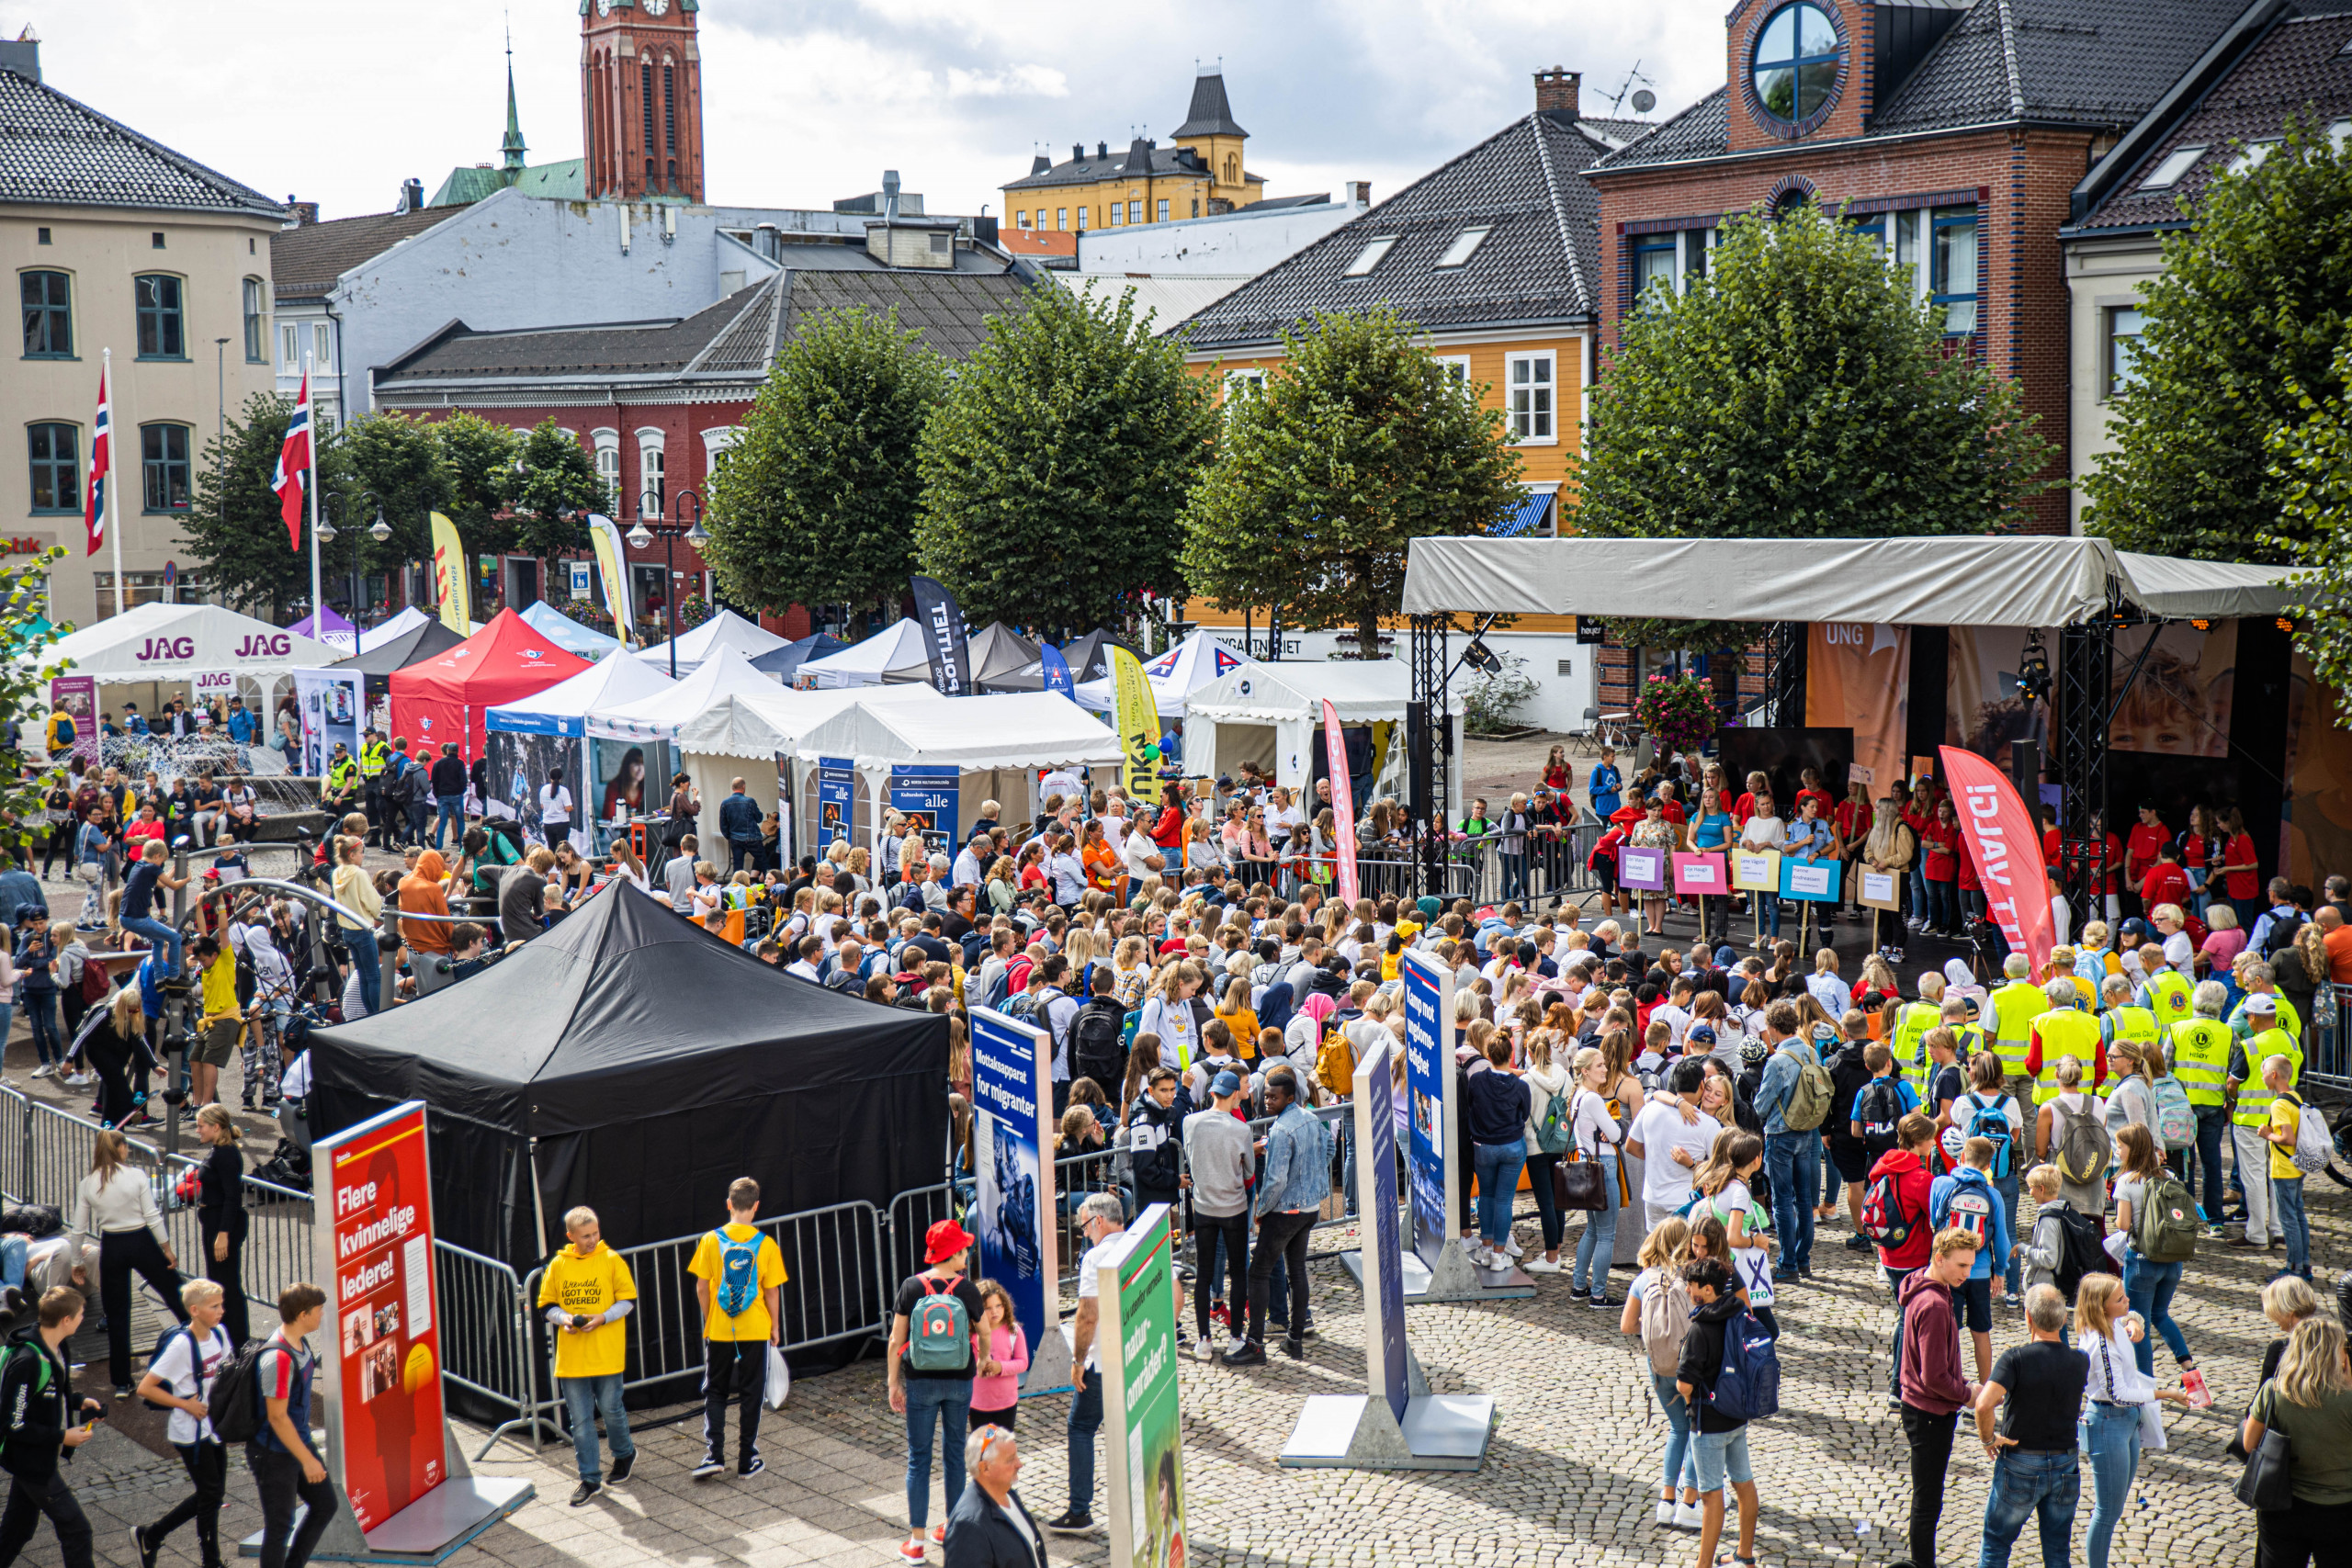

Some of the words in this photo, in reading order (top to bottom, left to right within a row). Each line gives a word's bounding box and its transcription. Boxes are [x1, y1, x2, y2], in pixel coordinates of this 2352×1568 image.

[1580, 626, 1601, 636] høyer
[1826, 624, 1863, 645] UNG
[136, 637, 195, 660] JAG
[235, 634, 291, 657] JAG
[197, 672, 232, 687] JAG
[835, 787, 848, 800] alle
[925, 794, 948, 807] alle
[1407, 984, 1422, 1017] Kamp
[1422, 1001, 1435, 1023] mot
[2176, 996, 2183, 1005] L
[1407, 1017, 1435, 1050] ungdoms-
[2280, 1019, 2286, 1028] L
[2127, 1030, 2141, 1039] Lions
[2198, 1033, 2206, 1043] L
[975, 1048, 1027, 1084] Mottaksapparat
[1408, 1041, 1430, 1077] ledighet
[977, 1073, 989, 1097] for
[991, 1083, 1035, 1118] migranter
[1865, 1121, 1894, 1134] FILA
[336, 1151, 351, 1163] Spania
[2082, 1151, 2098, 1179] adidas
[337, 1180, 378, 1216] Flere
[340, 1205, 415, 1258] kvinnelige
[342, 1250, 394, 1302] ledere!
[563, 1296, 600, 1305] COVERED!
[565, 1289, 582, 1297] GOT
[584, 1288, 601, 1296] YOU
[1749, 1291, 1769, 1300] FFO
[1125, 1317, 1151, 1368] natur-
[1126, 1332, 1168, 1413] områder?
